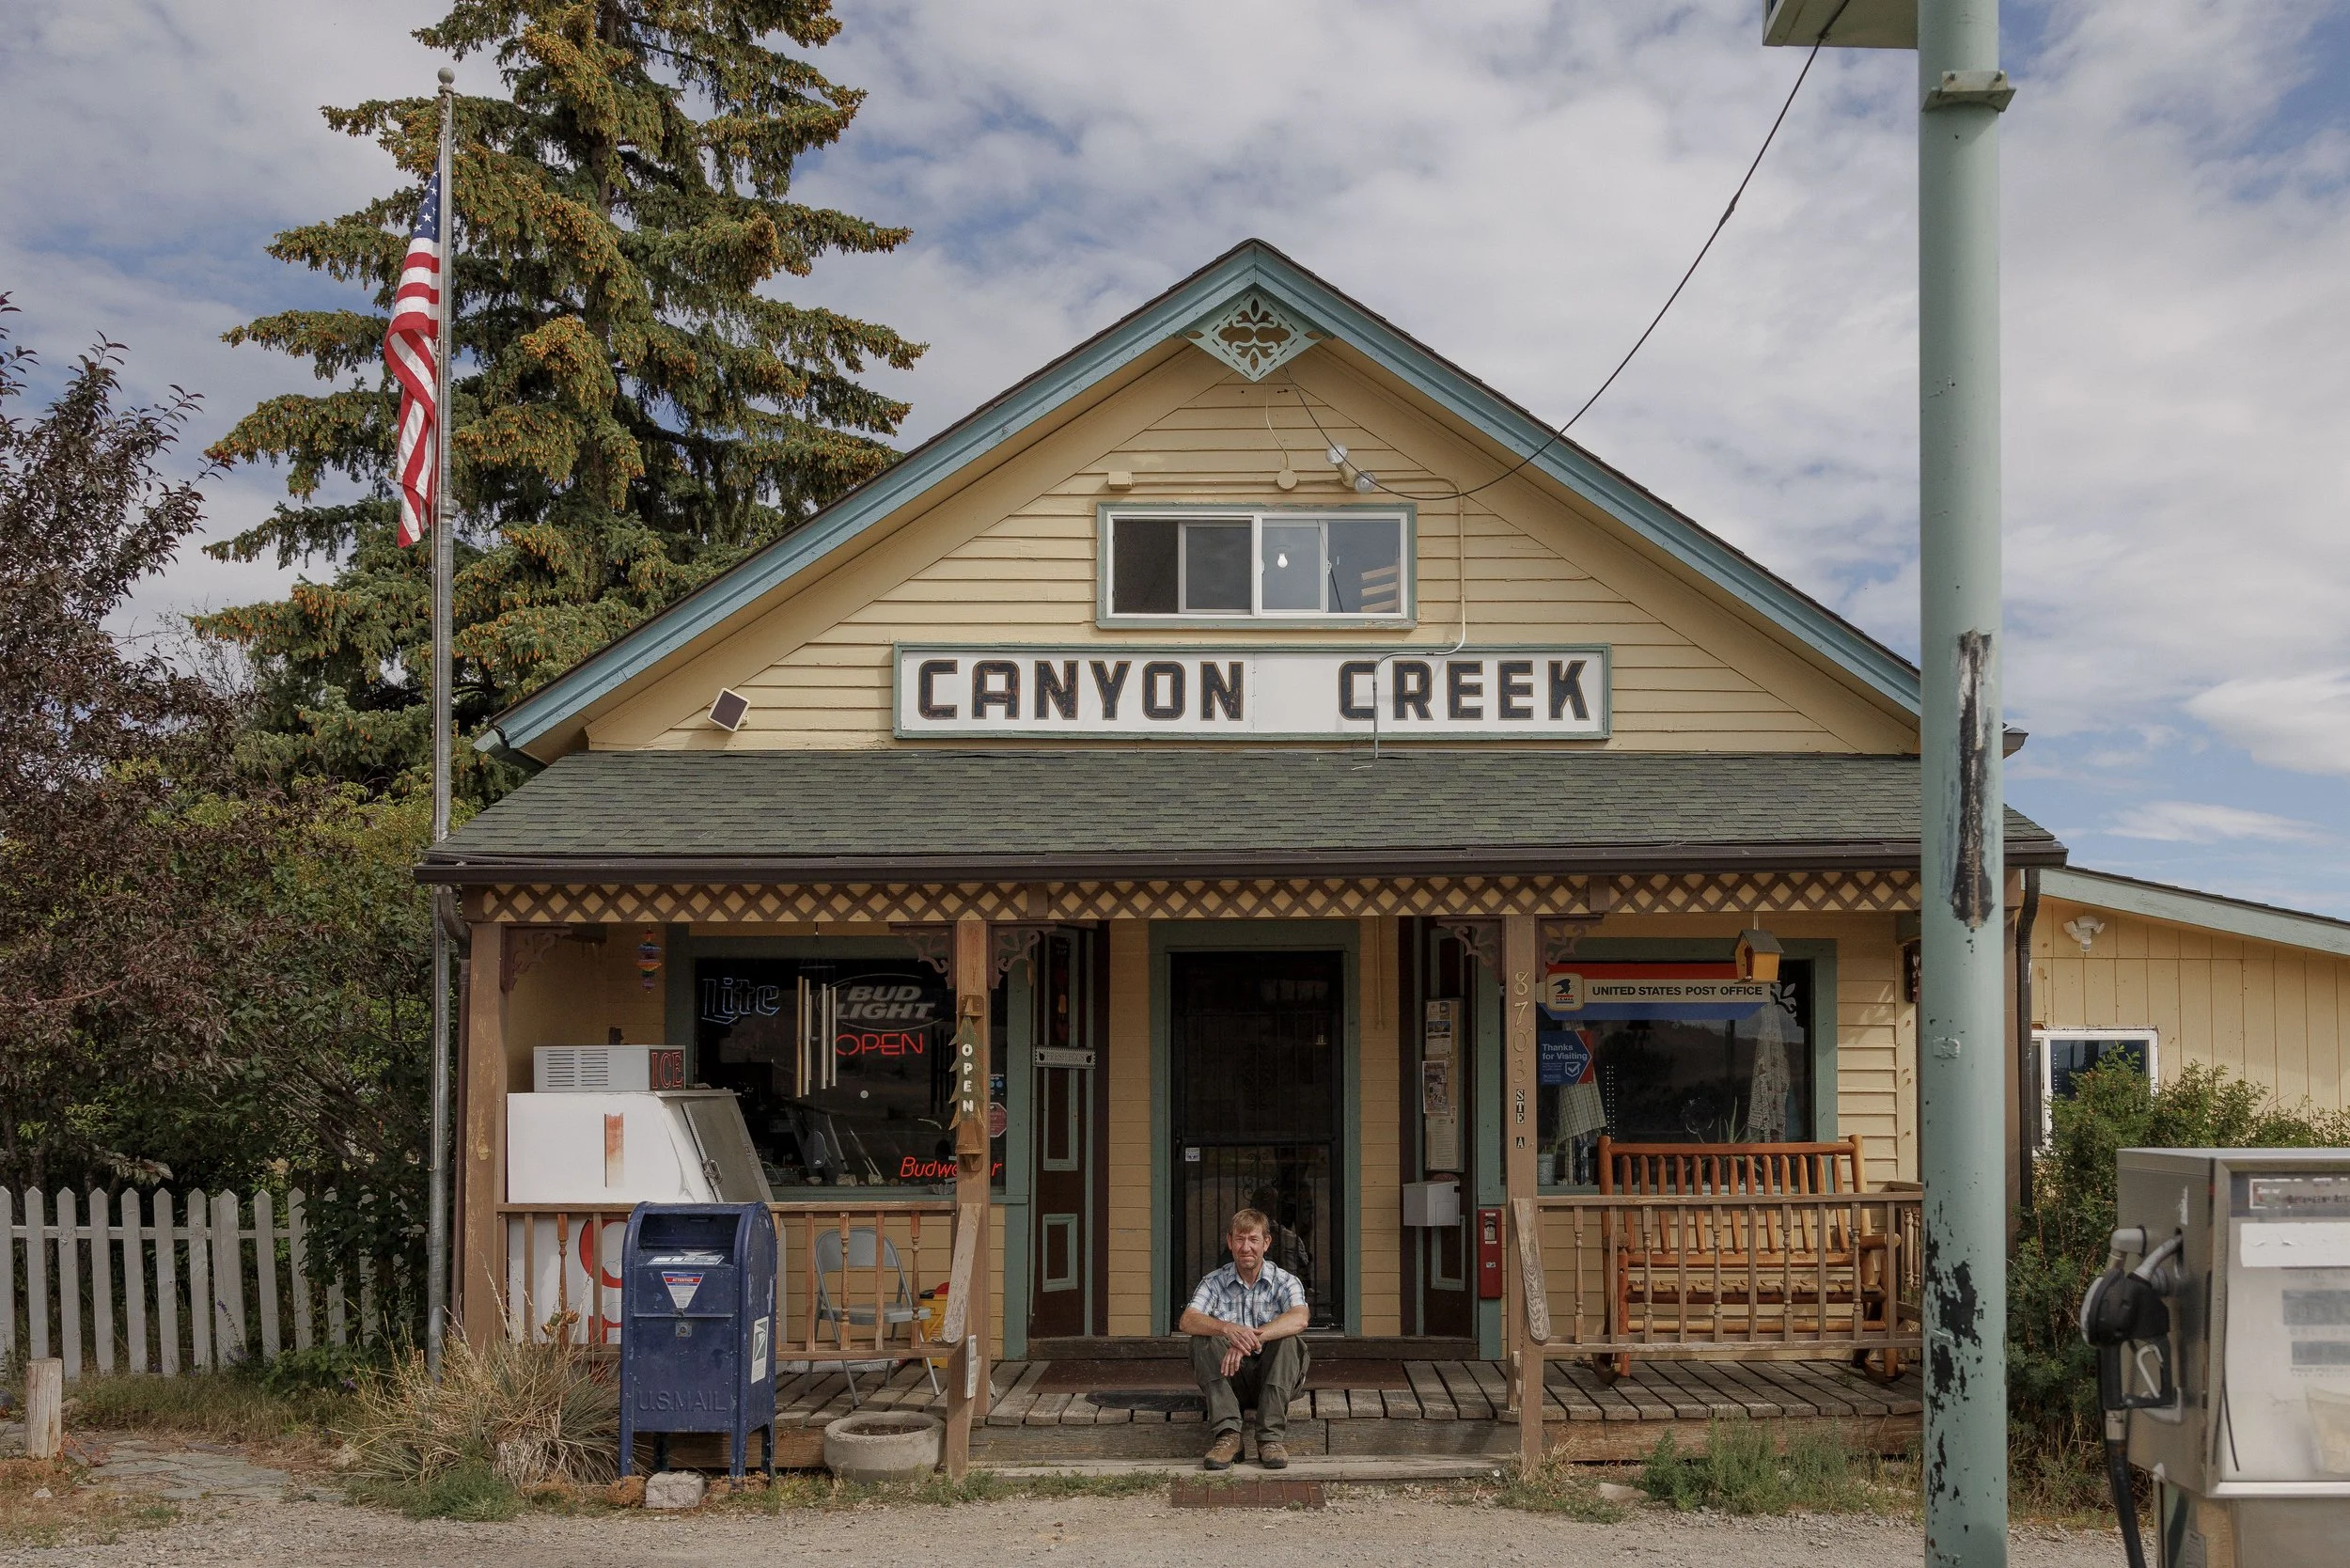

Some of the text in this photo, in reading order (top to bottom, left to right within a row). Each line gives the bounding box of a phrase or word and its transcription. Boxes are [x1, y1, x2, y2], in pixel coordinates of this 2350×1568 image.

[917, 659, 1588, 722] CANYON CREEK
[701, 977, 781, 1025] Lite
[847, 985, 923, 1002] BUD
[1592, 986, 1762, 996] UNITED STATES POST OFFICE
[836, 1002, 936, 1020] LIGHT
[835, 1031, 924, 1056] OPEN
[1542, 1052, 1588, 1061] for Visiting
[651, 1050, 683, 1090] ICE
[962, 1043, 974, 1112] OPEN
